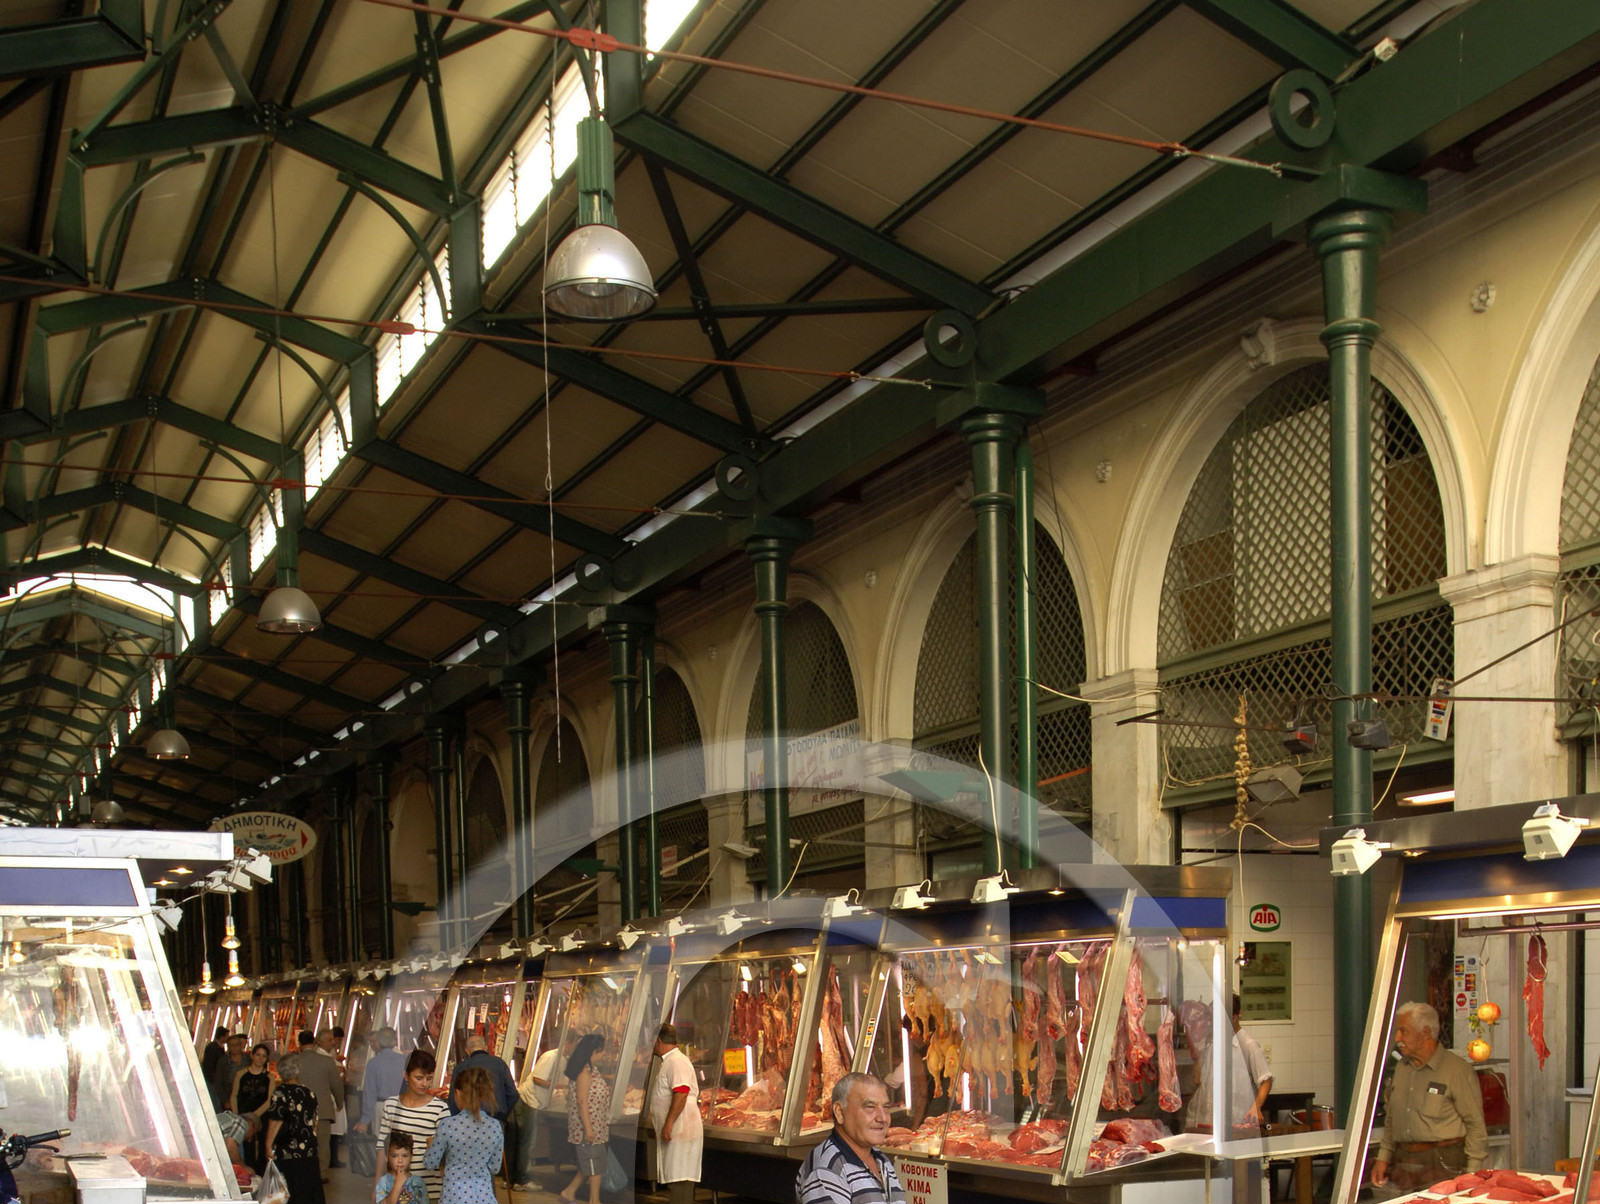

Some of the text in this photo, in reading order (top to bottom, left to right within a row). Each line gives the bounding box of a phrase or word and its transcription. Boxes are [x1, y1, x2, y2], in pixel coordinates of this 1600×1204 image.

[223, 815, 297, 831] ΔΗΜΟΤΙΚΗ
[901, 1164, 938, 1178] ΚΟΒΟΥΜΕ
[907, 1179, 931, 1194] ΚΙΜΑ
